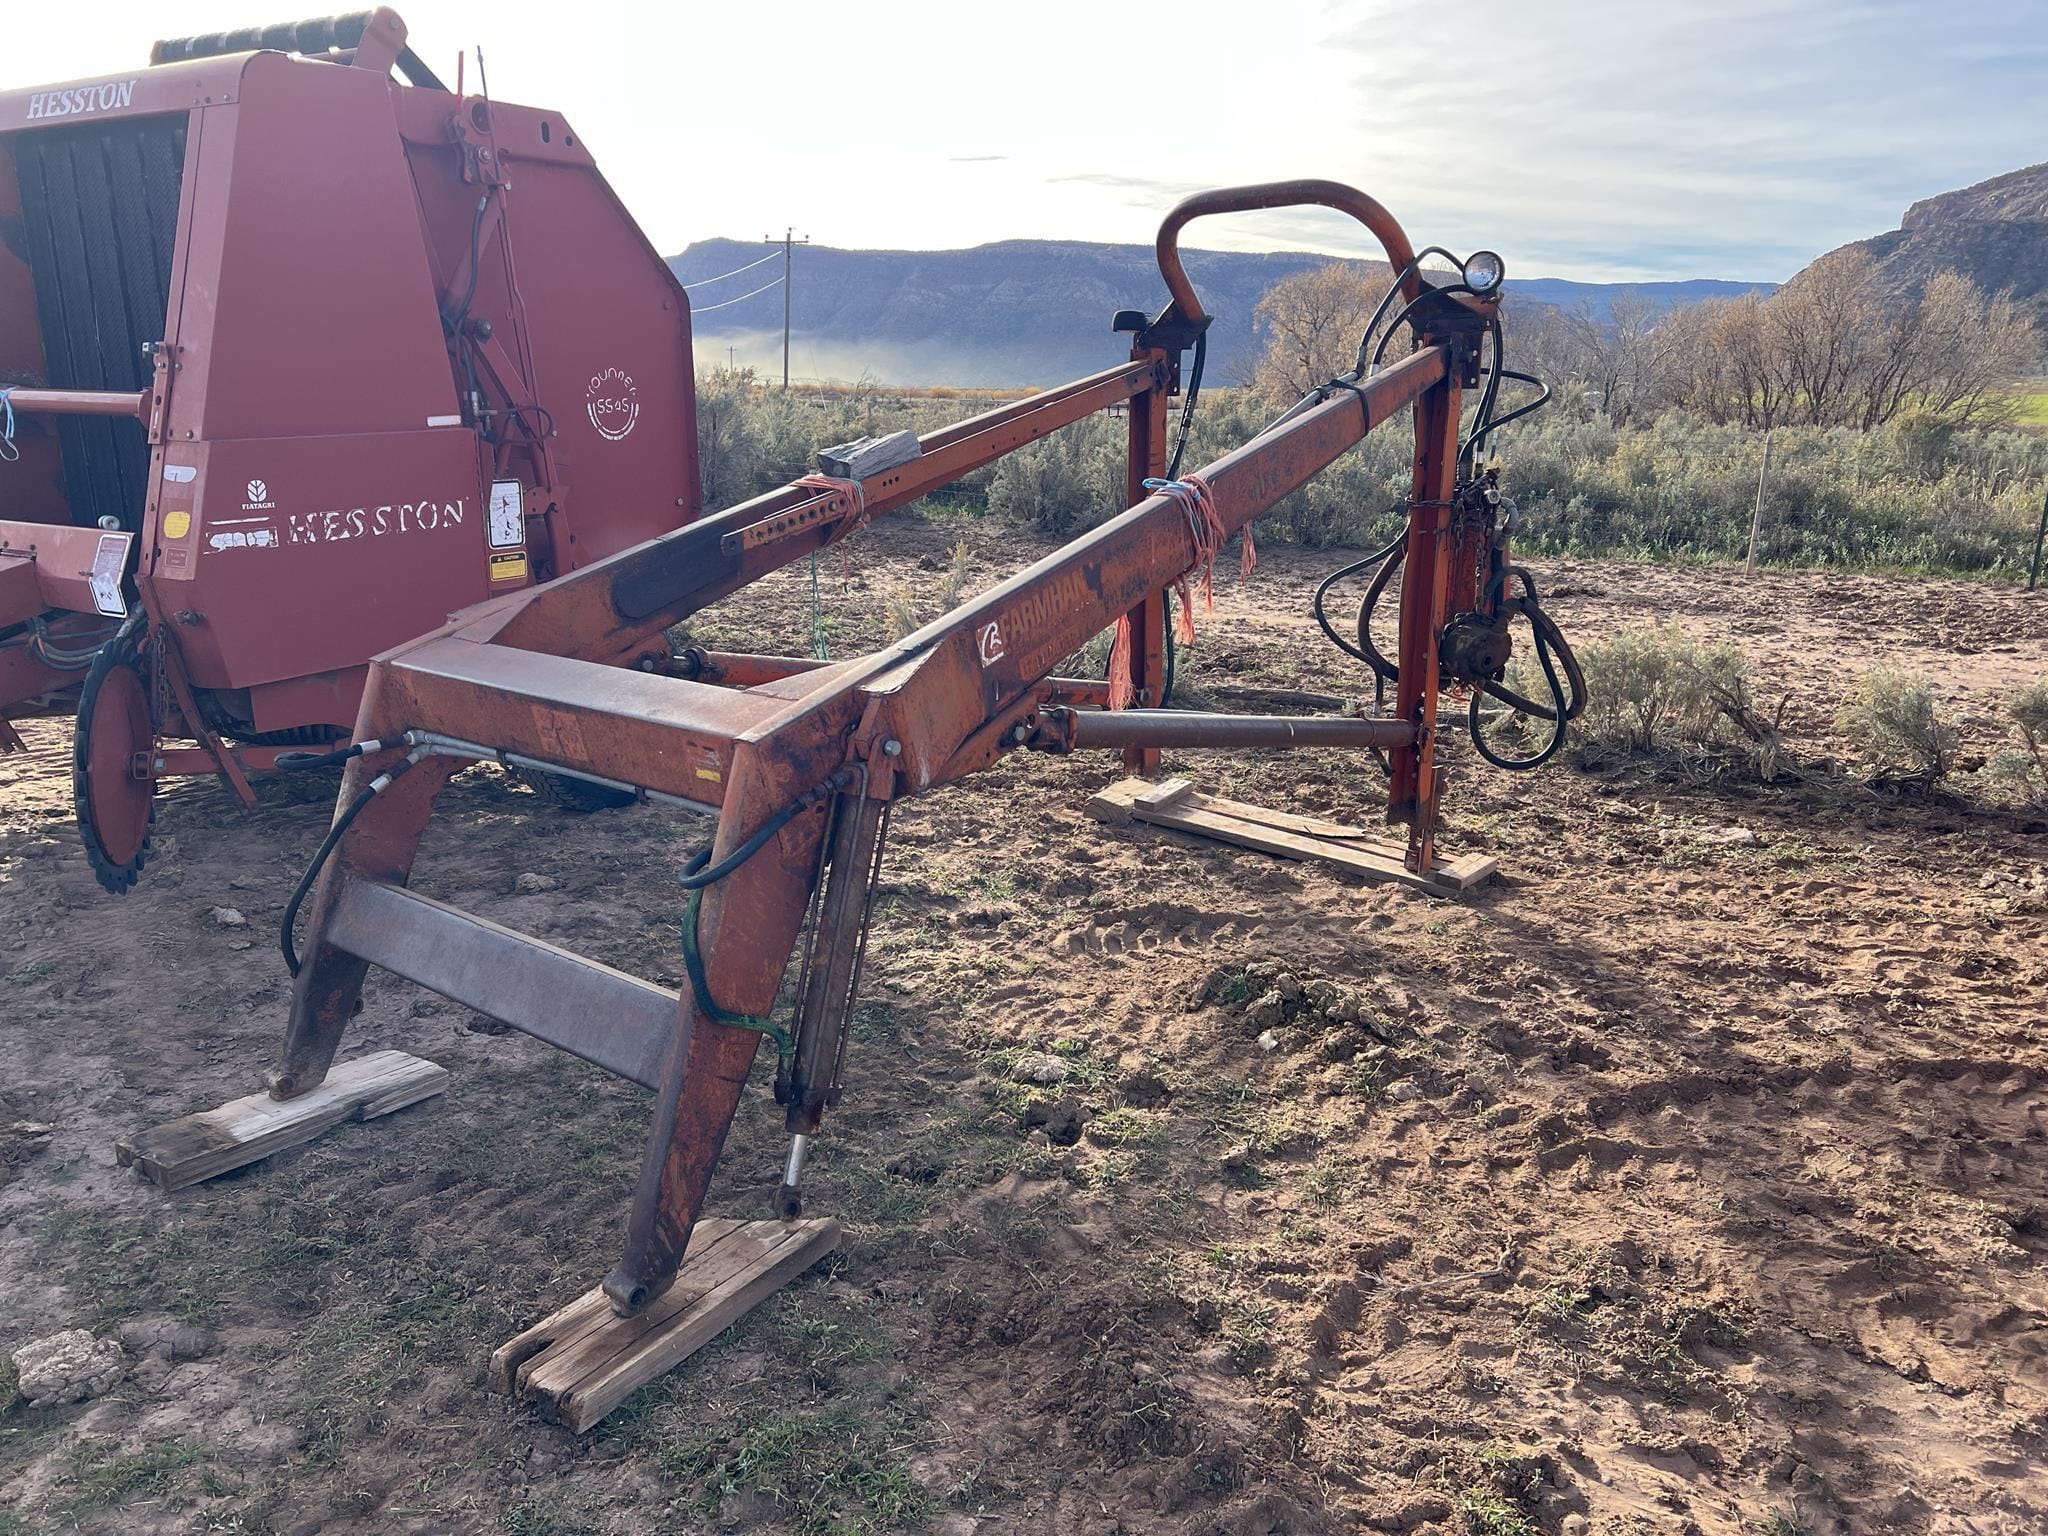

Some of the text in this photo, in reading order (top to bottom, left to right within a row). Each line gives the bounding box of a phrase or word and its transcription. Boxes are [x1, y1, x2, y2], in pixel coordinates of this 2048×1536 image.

[26, 80, 137, 119] HESSTON
[241, 501, 276, 511] FIATAGRI
[288, 499, 463, 545] HESSTON
[1000, 564, 1096, 643] FARMHAN
